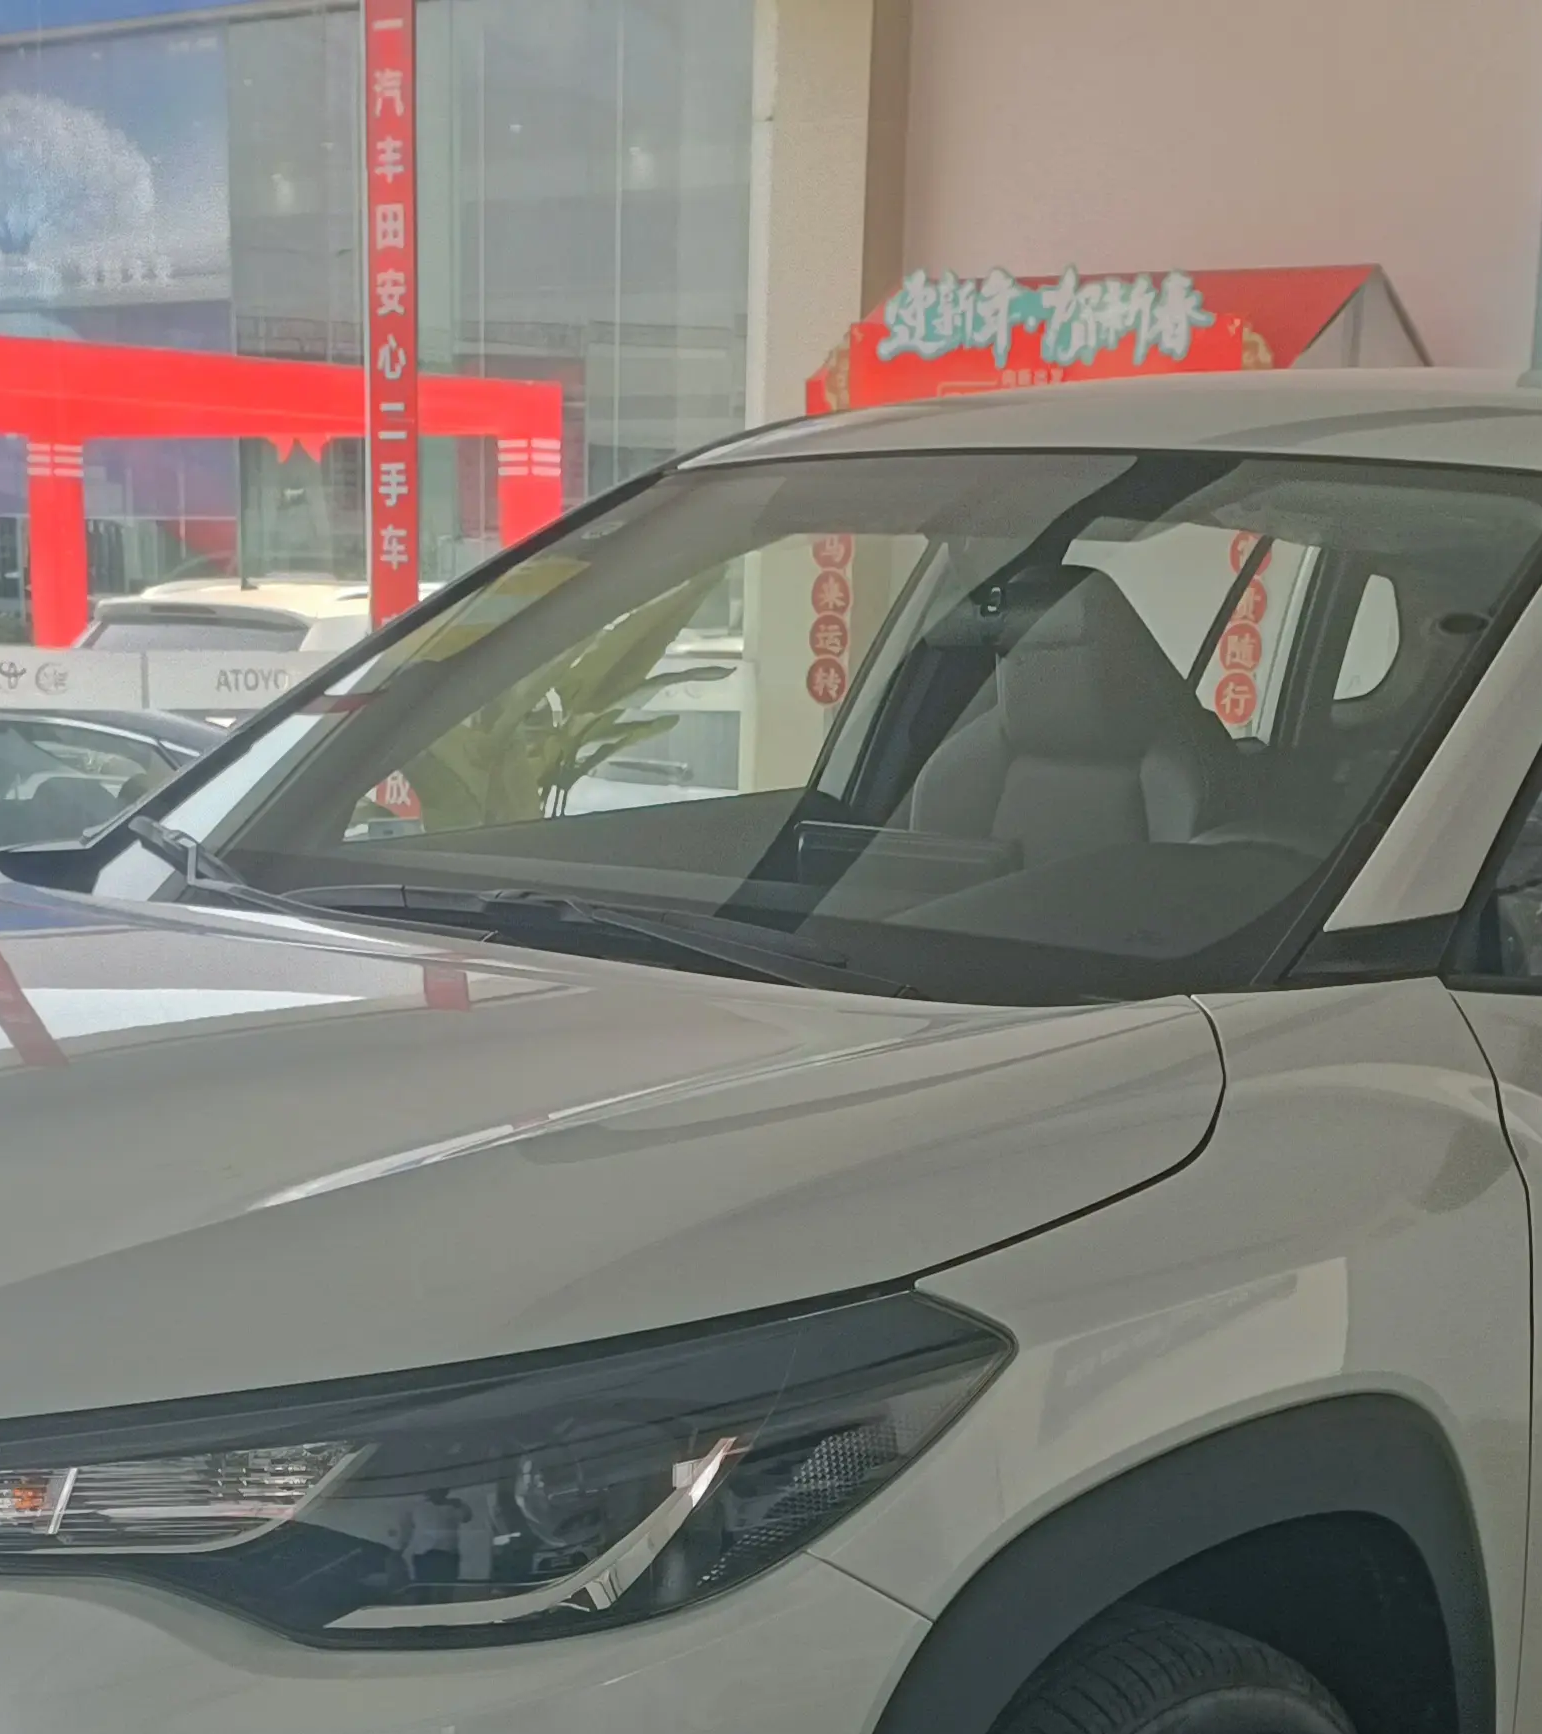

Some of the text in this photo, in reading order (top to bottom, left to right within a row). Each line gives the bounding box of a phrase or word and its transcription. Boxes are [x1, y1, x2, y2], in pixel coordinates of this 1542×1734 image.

[372, 18, 409, 570] 一汽丰田安心二手车
